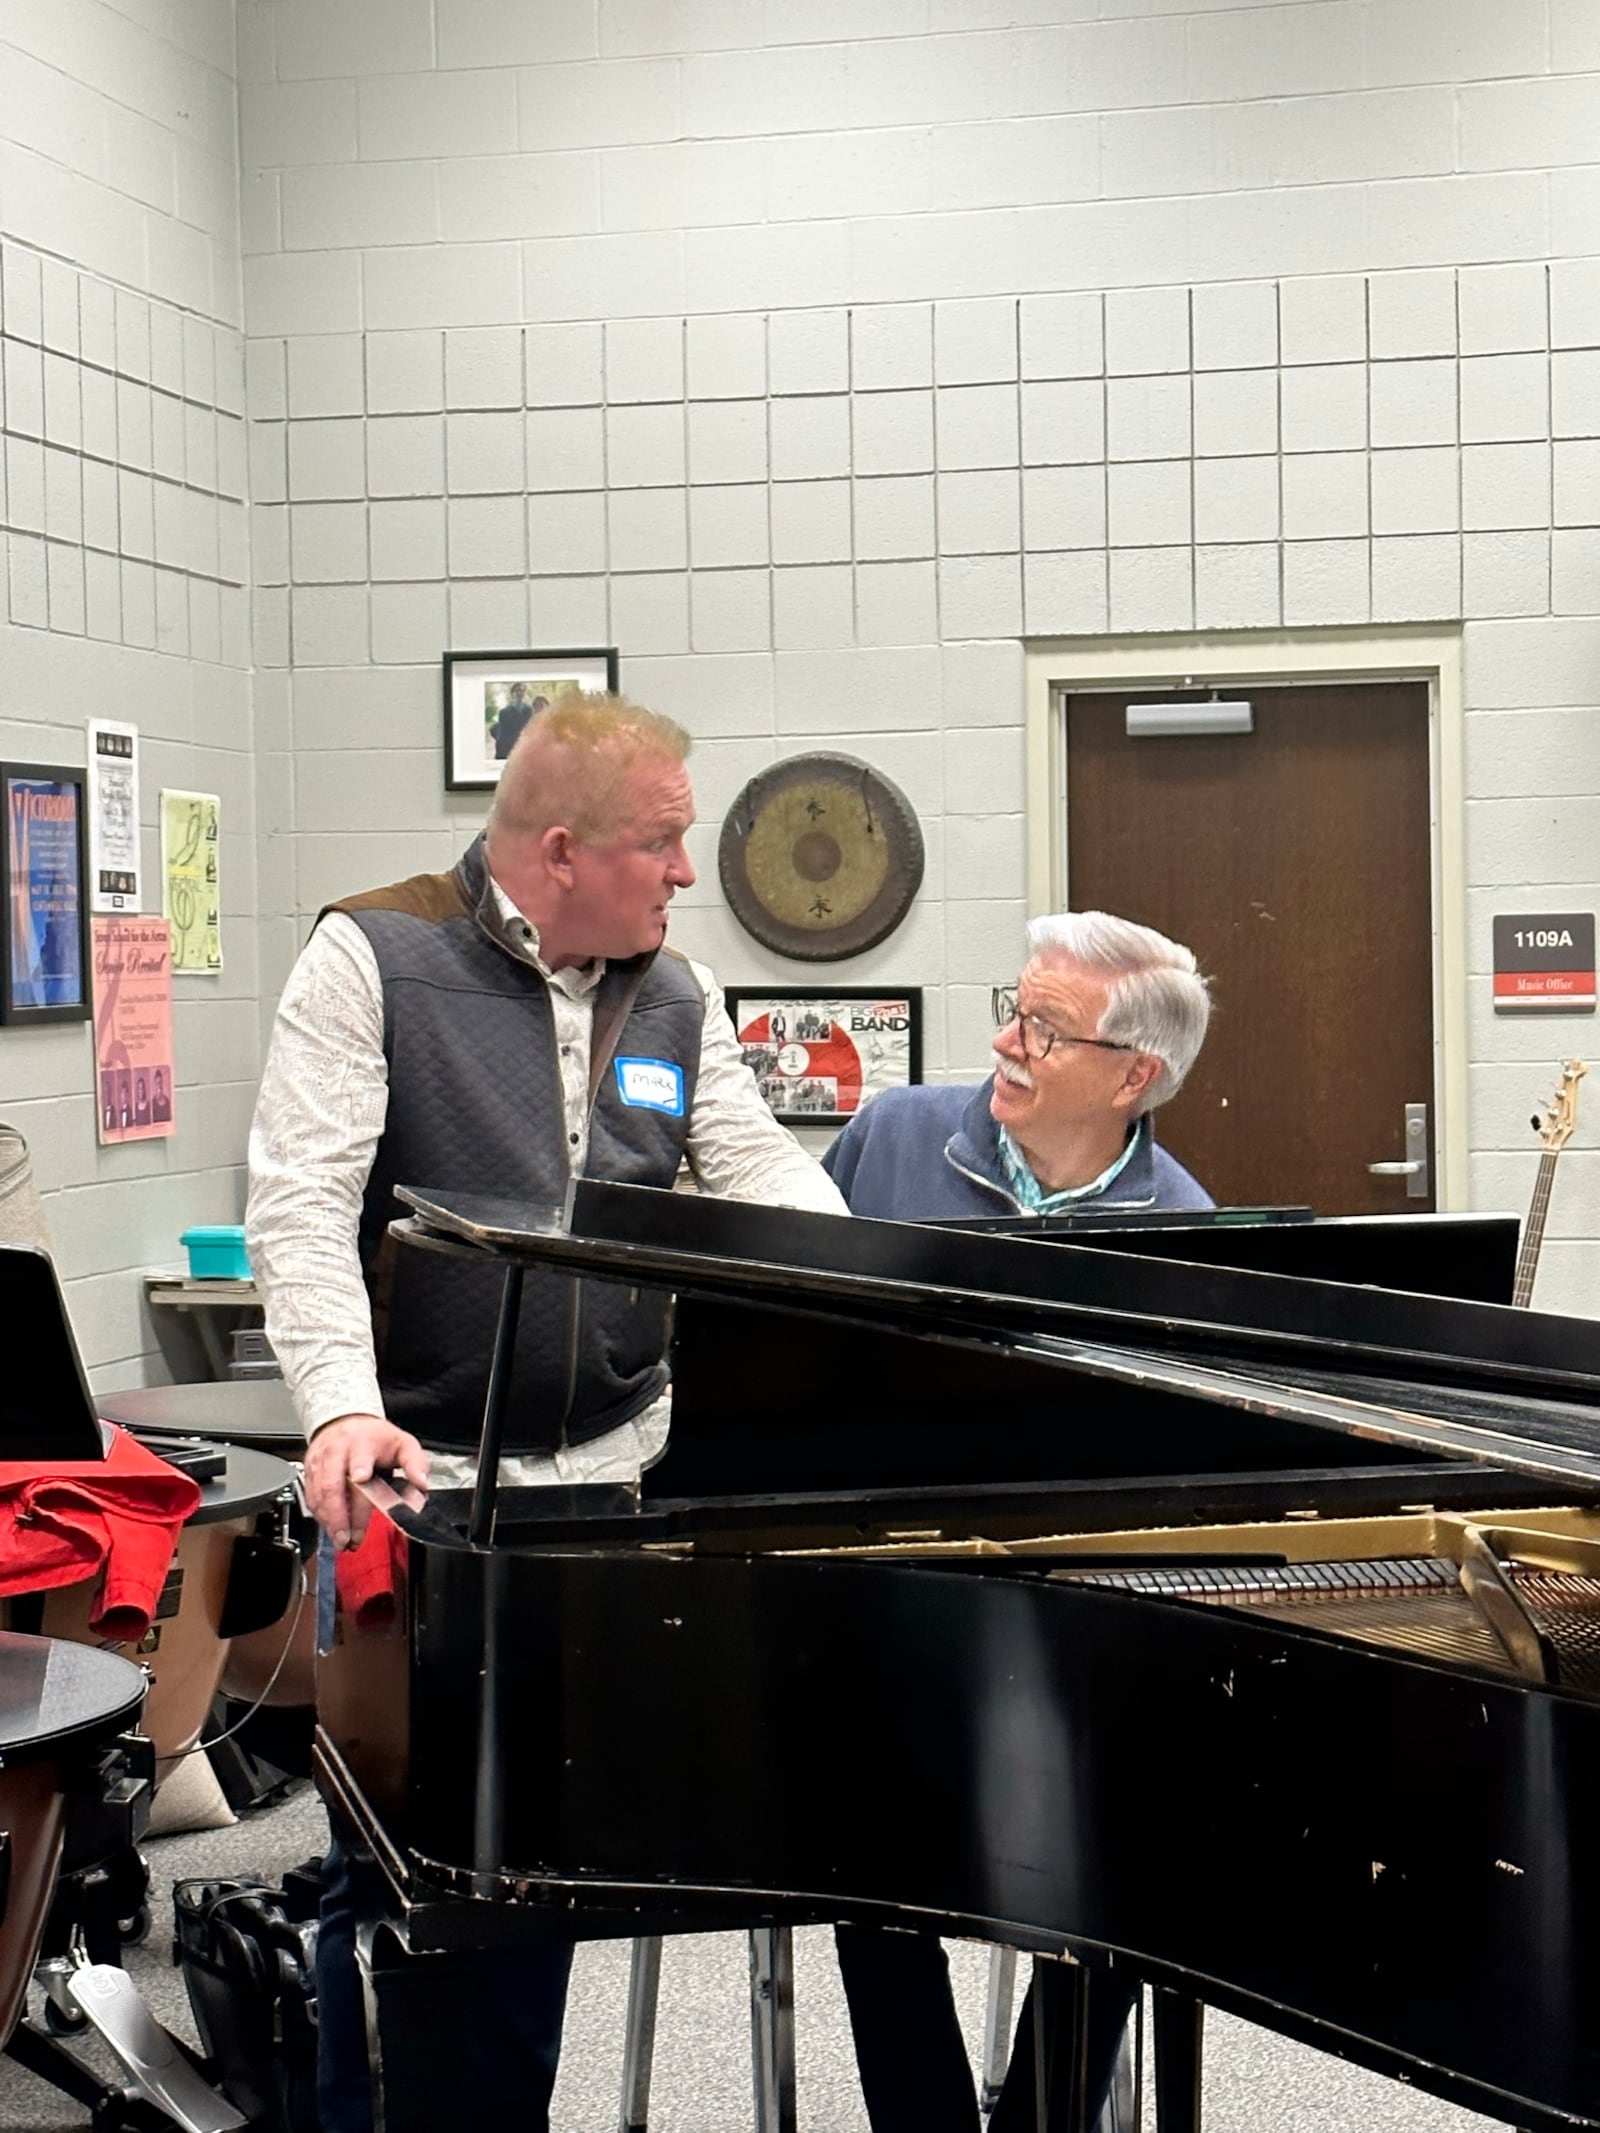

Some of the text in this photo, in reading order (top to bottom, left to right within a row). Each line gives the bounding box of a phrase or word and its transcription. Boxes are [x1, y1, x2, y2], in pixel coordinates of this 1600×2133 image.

[1514, 930, 1573, 947] 1109A
[1516, 978, 1574, 991] Music Office
[851, 1016, 909, 1031] BAND
